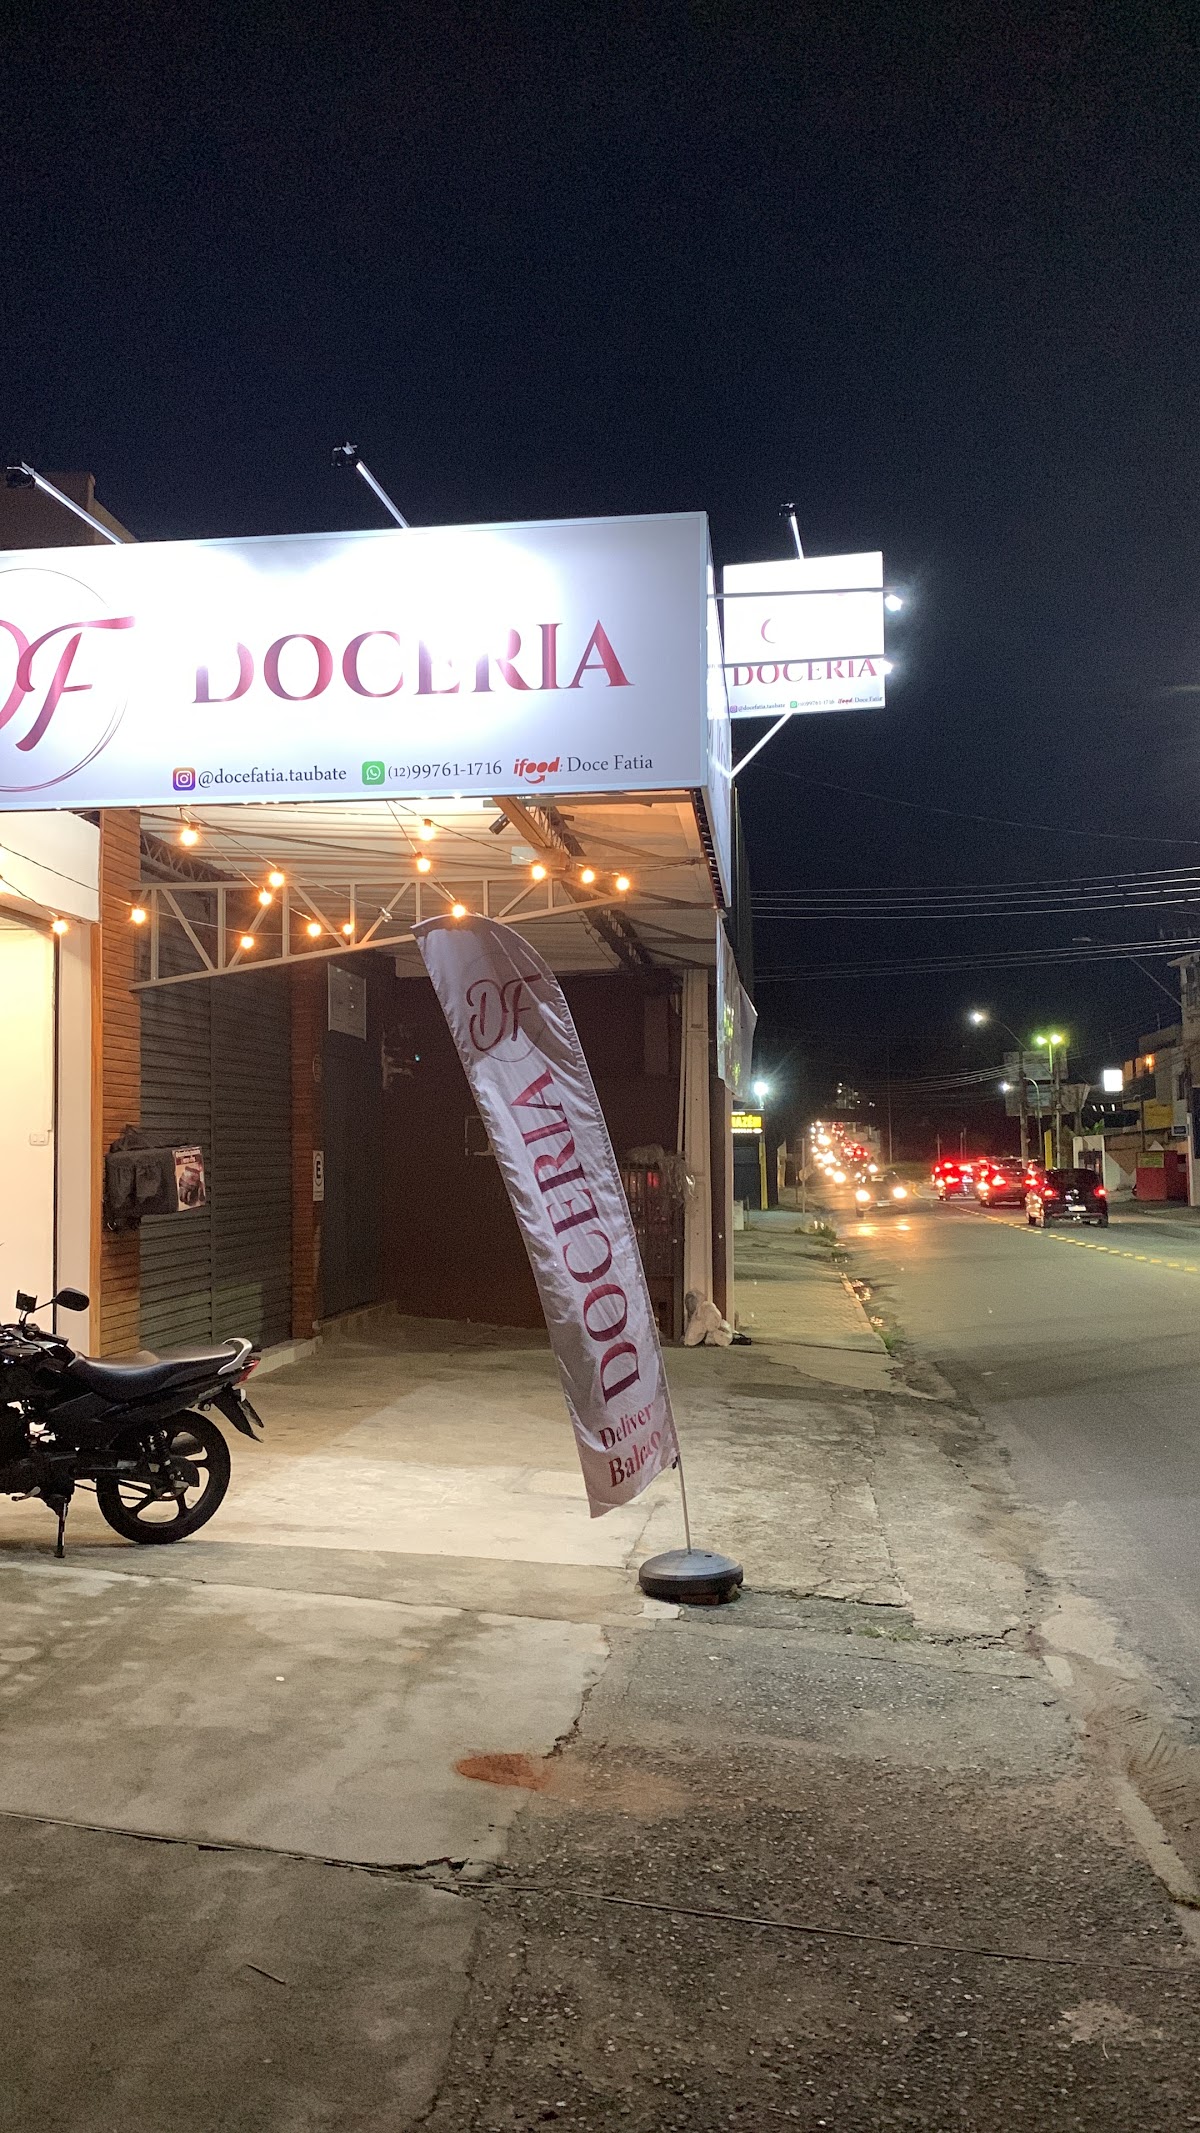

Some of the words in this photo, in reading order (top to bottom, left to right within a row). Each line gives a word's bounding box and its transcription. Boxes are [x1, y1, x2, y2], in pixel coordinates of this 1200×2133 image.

[192, 619, 636, 704] DOCERIA
[733, 658, 878, 687] DOCERIA
[198, 765, 347, 788] @docefatia.taubate
[388, 760, 503, 779] (12)99761-1716
[566, 755, 609, 773] Doce
[613, 754, 654, 770] Fatia
[466, 974, 542, 1052] DF
[316, 1160, 321, 1179] E
[511, 1069, 642, 1404] DOCERIA
